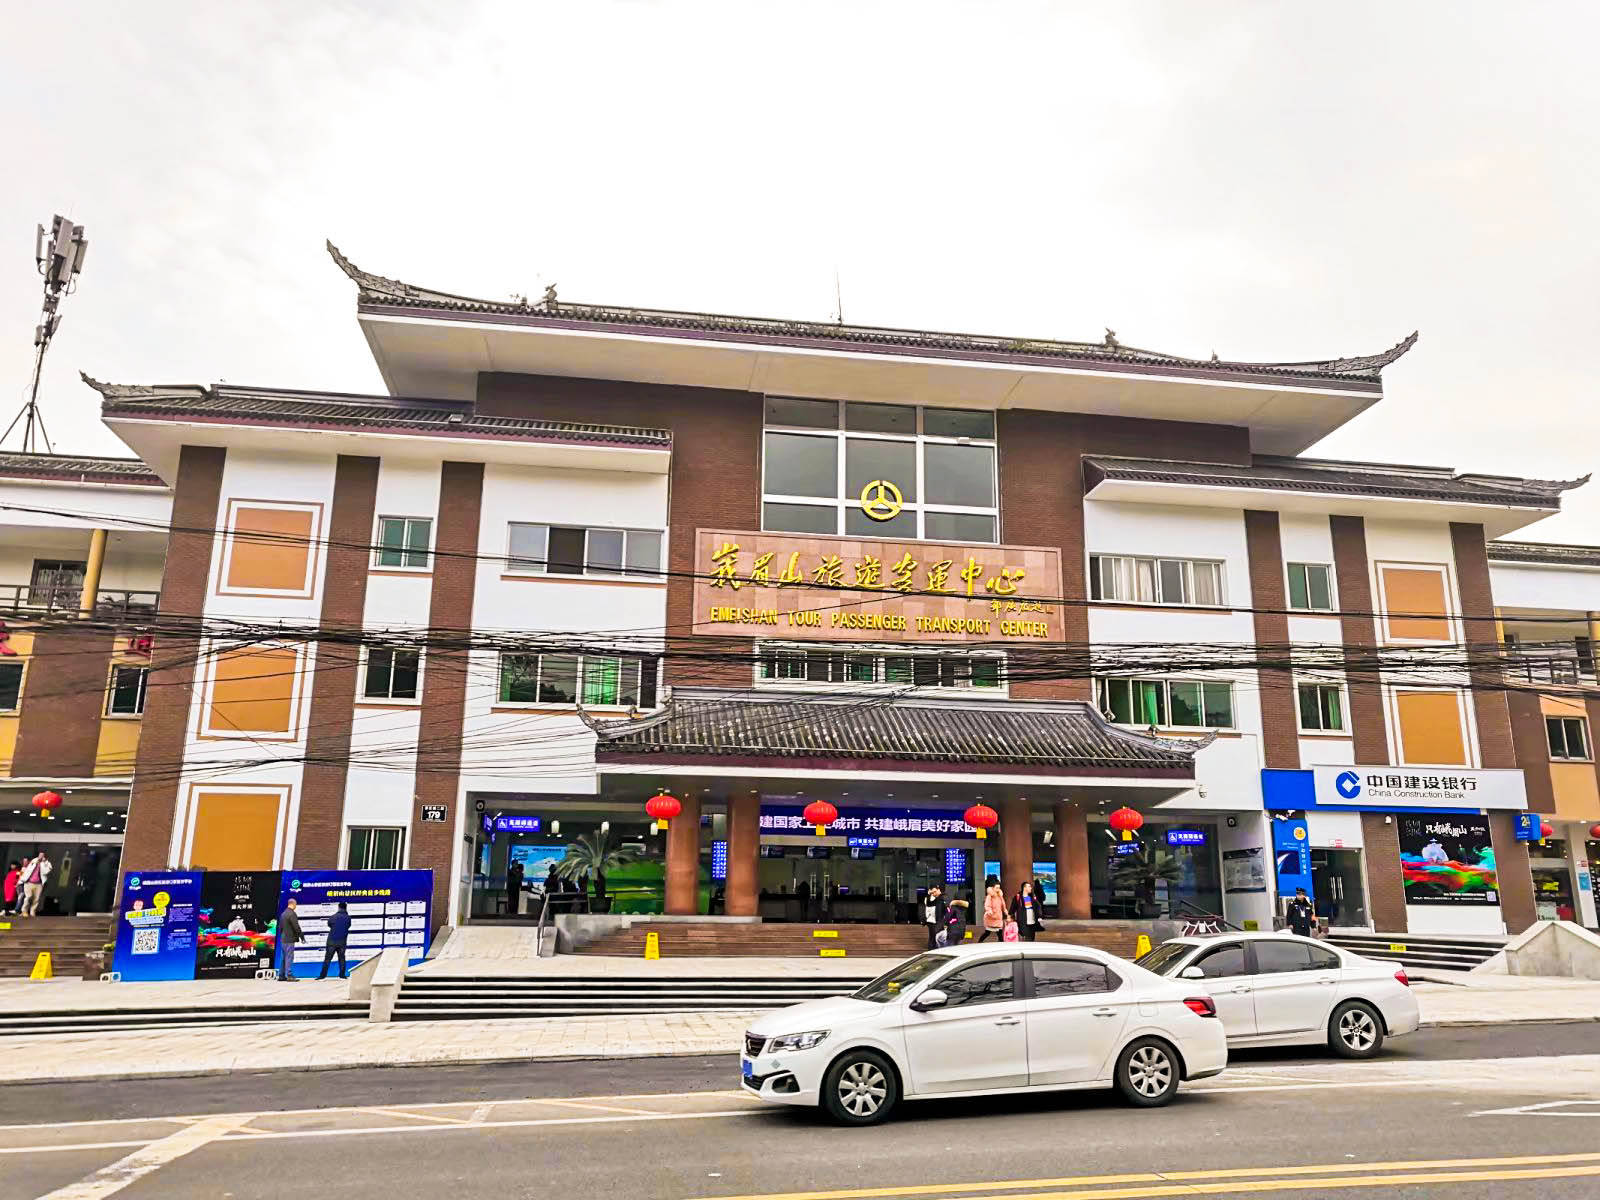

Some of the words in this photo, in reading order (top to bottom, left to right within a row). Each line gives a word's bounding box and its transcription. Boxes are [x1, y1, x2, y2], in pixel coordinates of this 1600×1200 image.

[710, 607, 778, 626] EMEISHAN
[788, 610, 822, 628] TOUR
[831, 612, 906, 631] PASSENGER
[916, 615, 991, 635] TRANSPORT
[1000, 619, 1049, 639] CENTER
[1366, 774, 1477, 791] 中国建设银行
[1368, 789, 1392, 797] China
[1394, 789, 1443, 798] Construction
[1444, 791, 1465, 799] Bank
[427, 810, 441, 819] 179
[759, 815, 861, 831] 建国家城市
